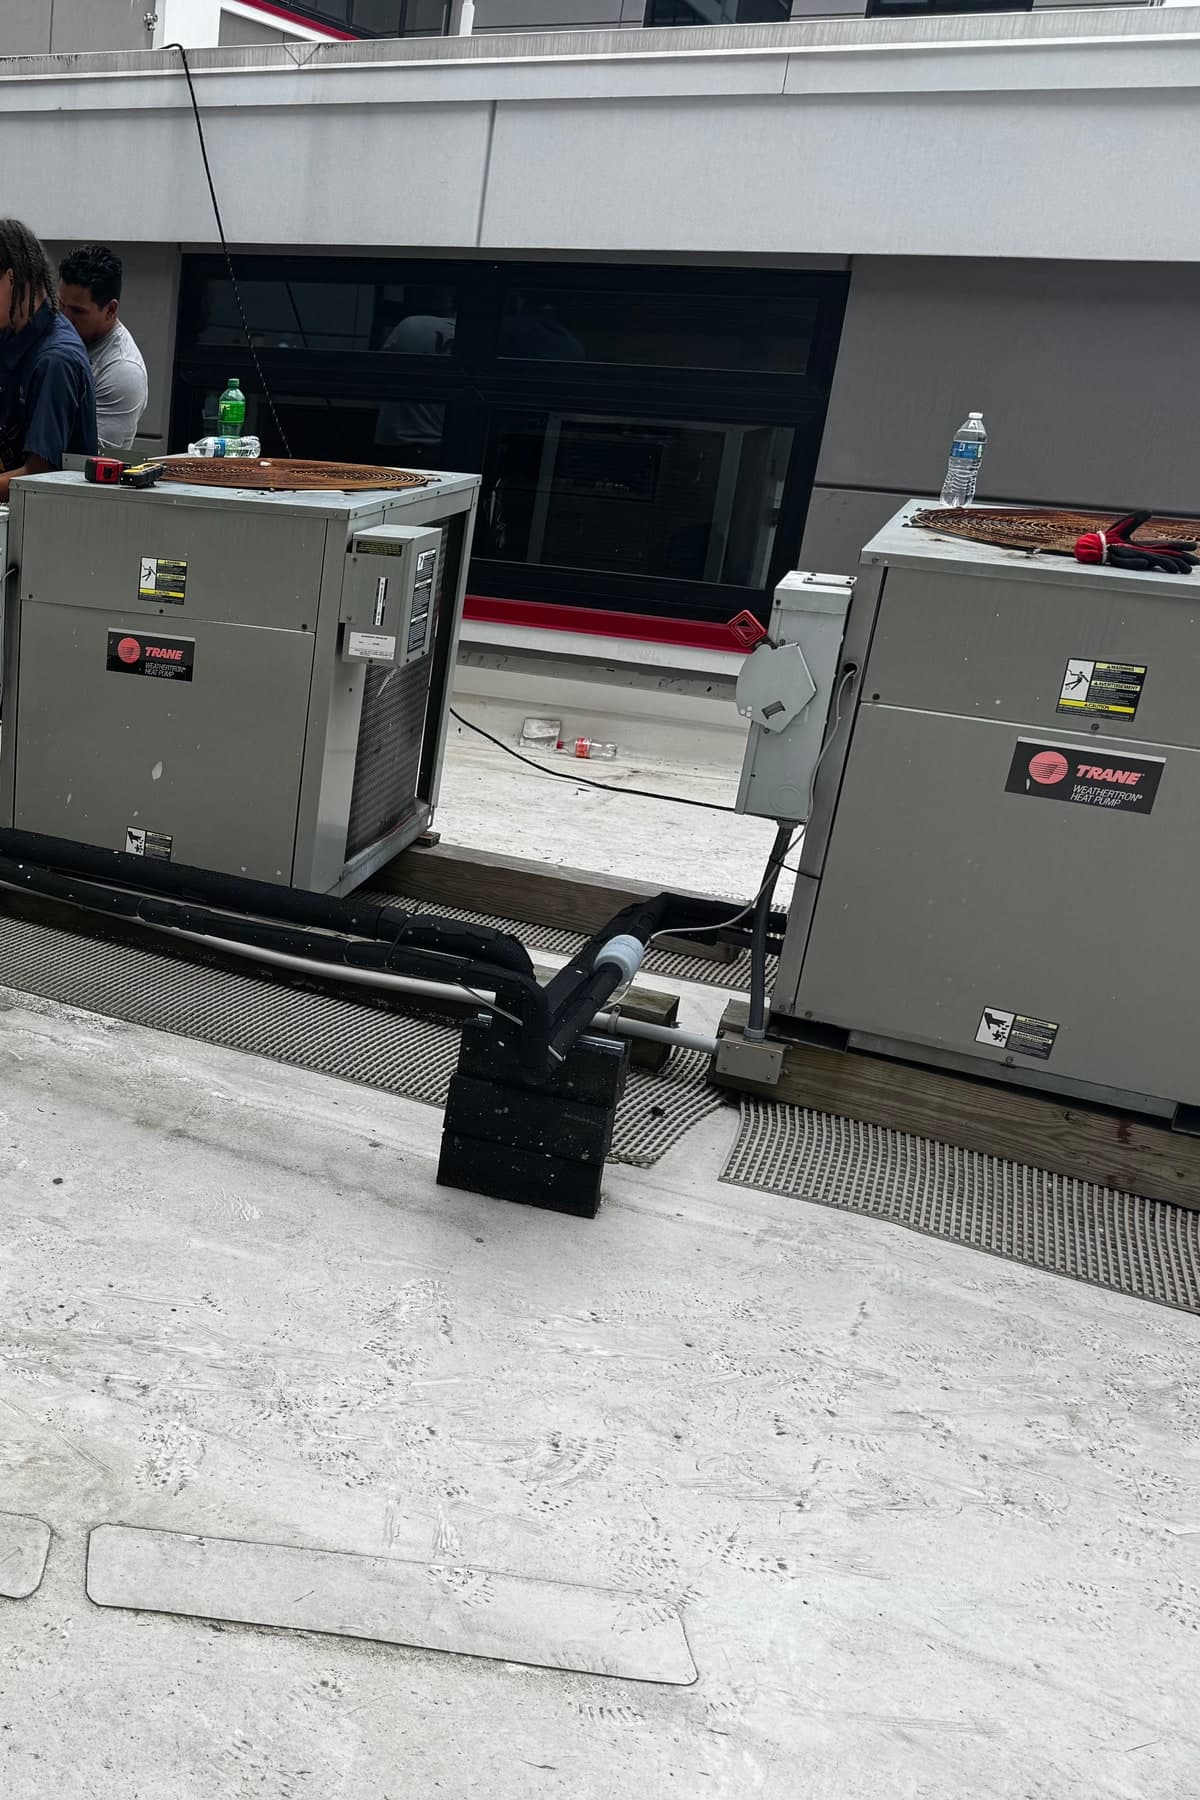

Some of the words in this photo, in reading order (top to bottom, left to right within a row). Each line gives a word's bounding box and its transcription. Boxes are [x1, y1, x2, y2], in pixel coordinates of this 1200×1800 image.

[145, 646, 184, 660] TRANE
[1076, 764, 1141, 785] TRANE
[1070, 792, 1093, 803] HEAT
[1094, 796, 1121, 807] PUMP
